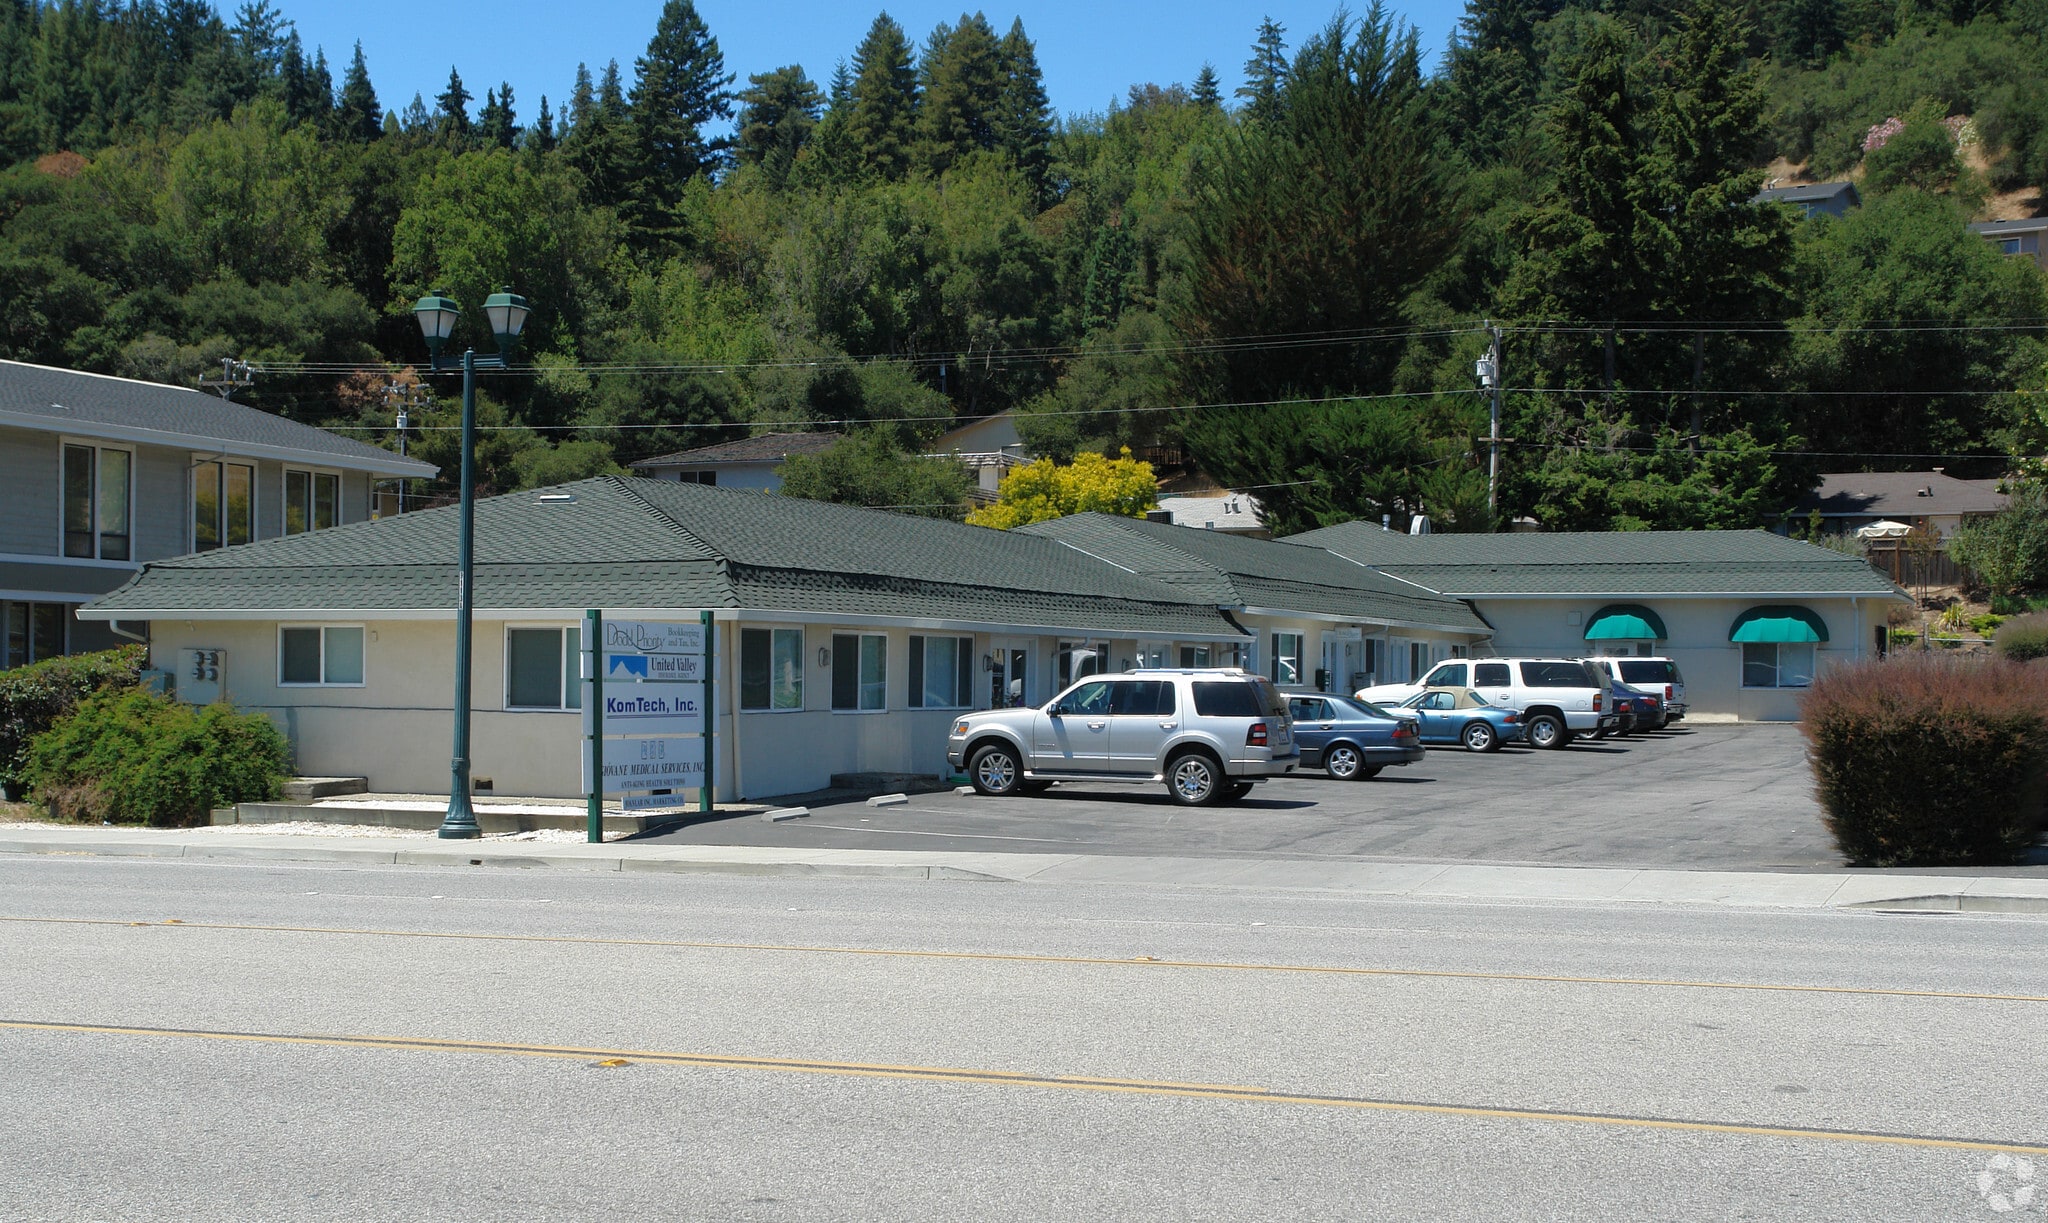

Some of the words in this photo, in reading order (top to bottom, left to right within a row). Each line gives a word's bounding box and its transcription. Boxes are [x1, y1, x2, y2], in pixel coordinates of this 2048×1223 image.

[668, 639, 678, 647] and
[651, 657, 675, 671] United
[676, 657, 697, 674] Valley
[607, 697, 670, 713] KomTech,
[675, 697, 698, 711] Inc.
[631, 763, 659, 775] MEDICAL
[661, 762, 691, 774] SERVICES,
[646, 779, 662, 788] HEALTH
